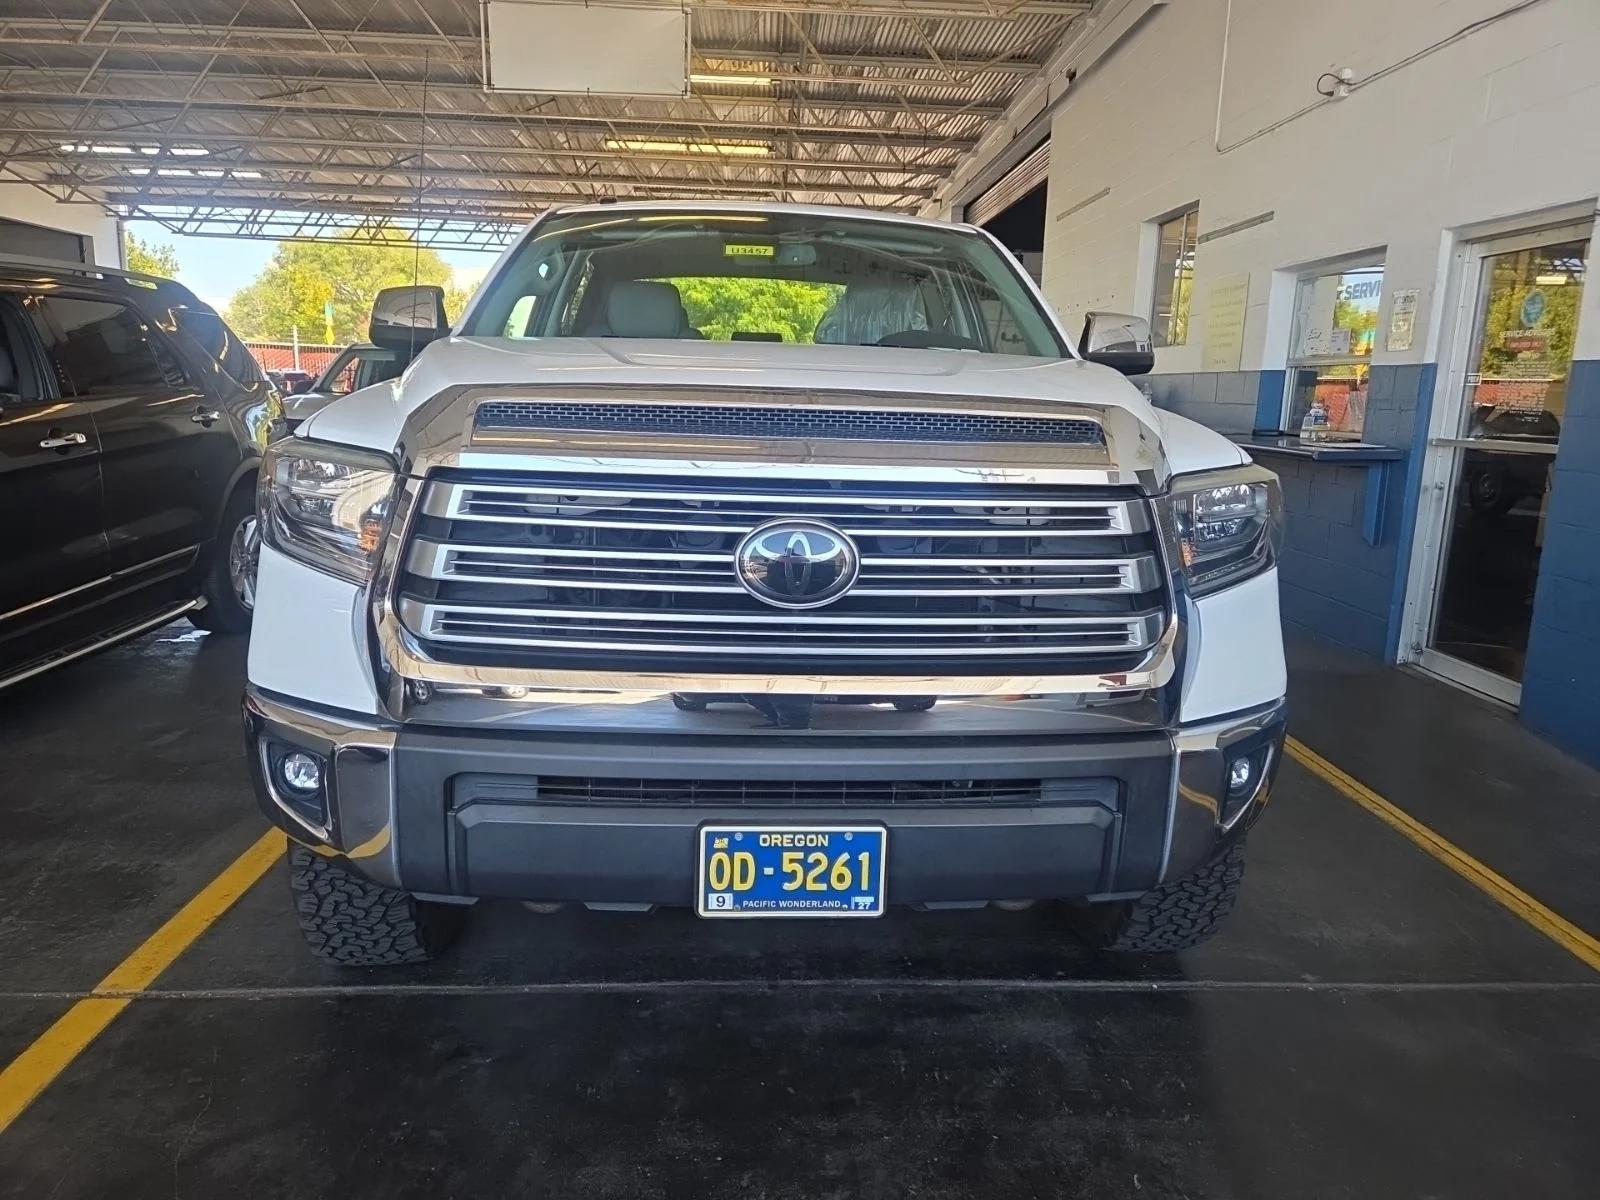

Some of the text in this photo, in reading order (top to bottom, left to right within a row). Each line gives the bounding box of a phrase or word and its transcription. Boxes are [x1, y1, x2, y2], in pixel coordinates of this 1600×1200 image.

[759, 834, 829, 847] OREGON
[716, 895, 726, 908] 9
[742, 899, 841, 908] PACIFIC WONDERLAND
[857, 902, 871, 910] 27
